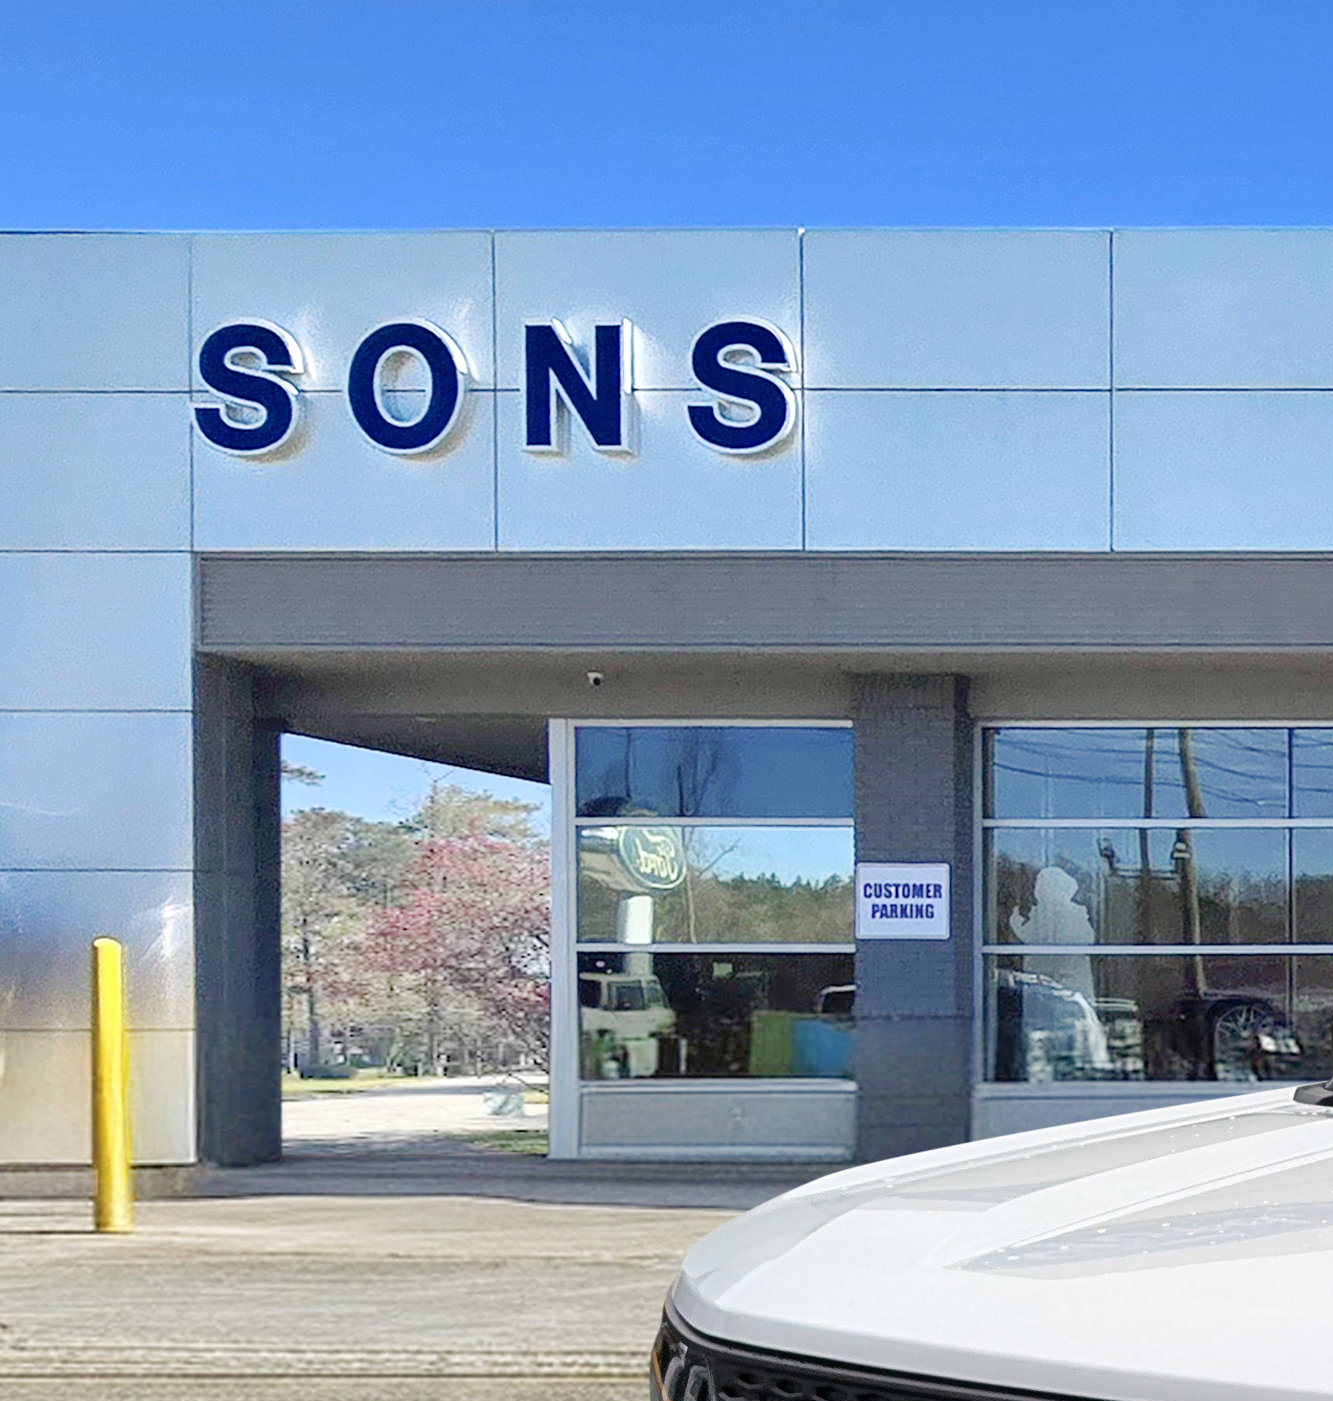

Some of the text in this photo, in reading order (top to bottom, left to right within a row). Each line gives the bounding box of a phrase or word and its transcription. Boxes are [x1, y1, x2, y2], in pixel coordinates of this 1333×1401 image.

[193, 319, 798, 455] SONS
[863, 882, 943, 899] CUSTOMER
[871, 903, 935, 919] PARKING
